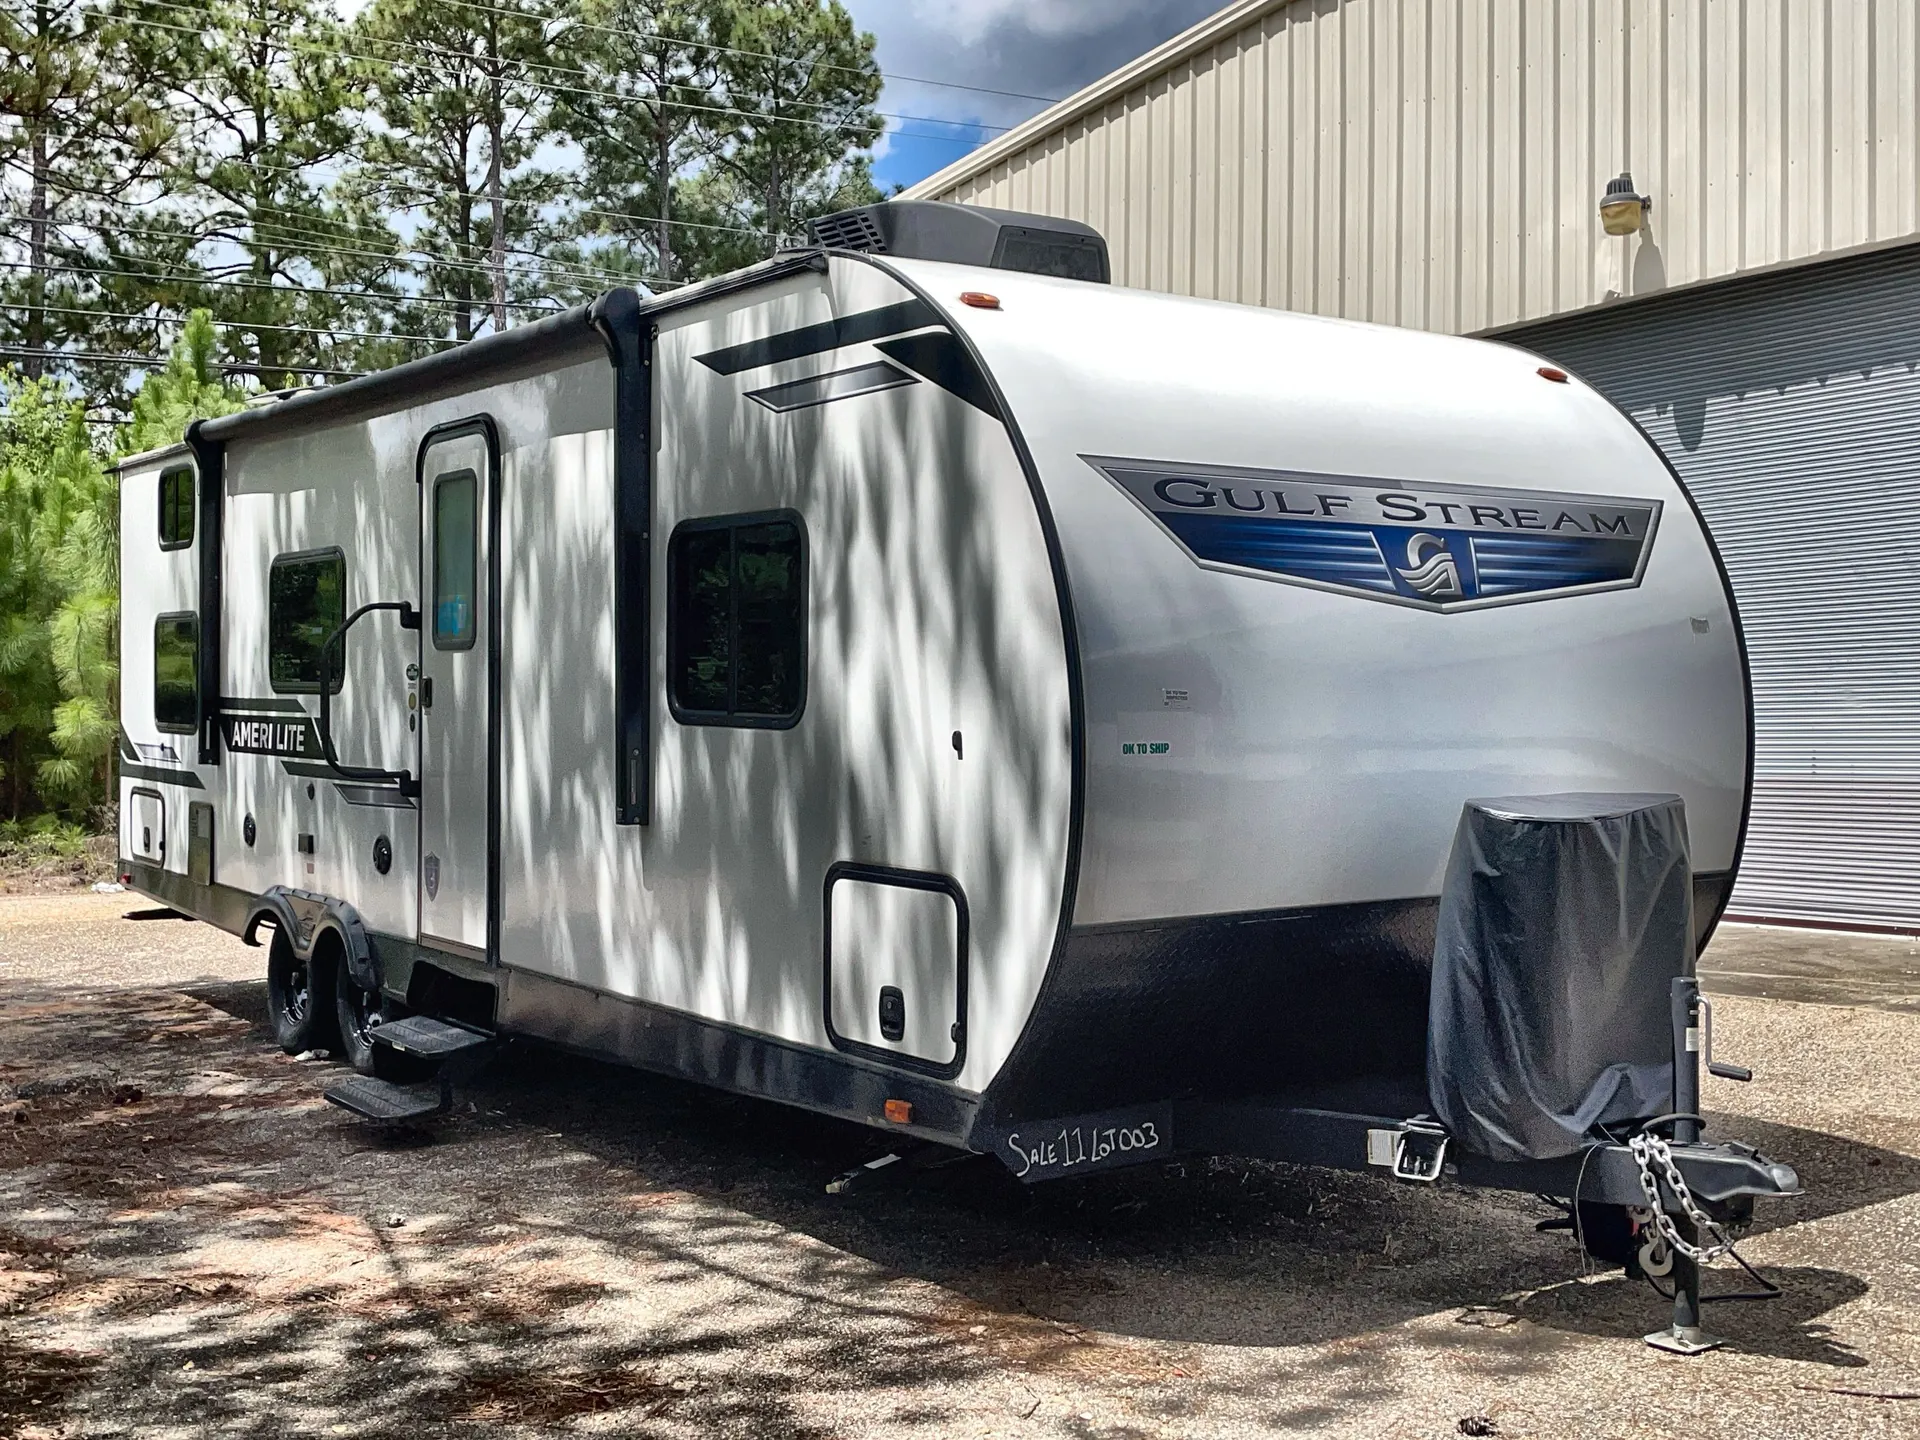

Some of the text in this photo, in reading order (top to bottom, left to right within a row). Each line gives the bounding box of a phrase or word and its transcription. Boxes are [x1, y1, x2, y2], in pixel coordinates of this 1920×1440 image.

[1153, 478, 1636, 536] GULF STREAM
[232, 721, 305, 752] AMERI LITE
[1122, 742, 1170, 755] OK TO SHIP
